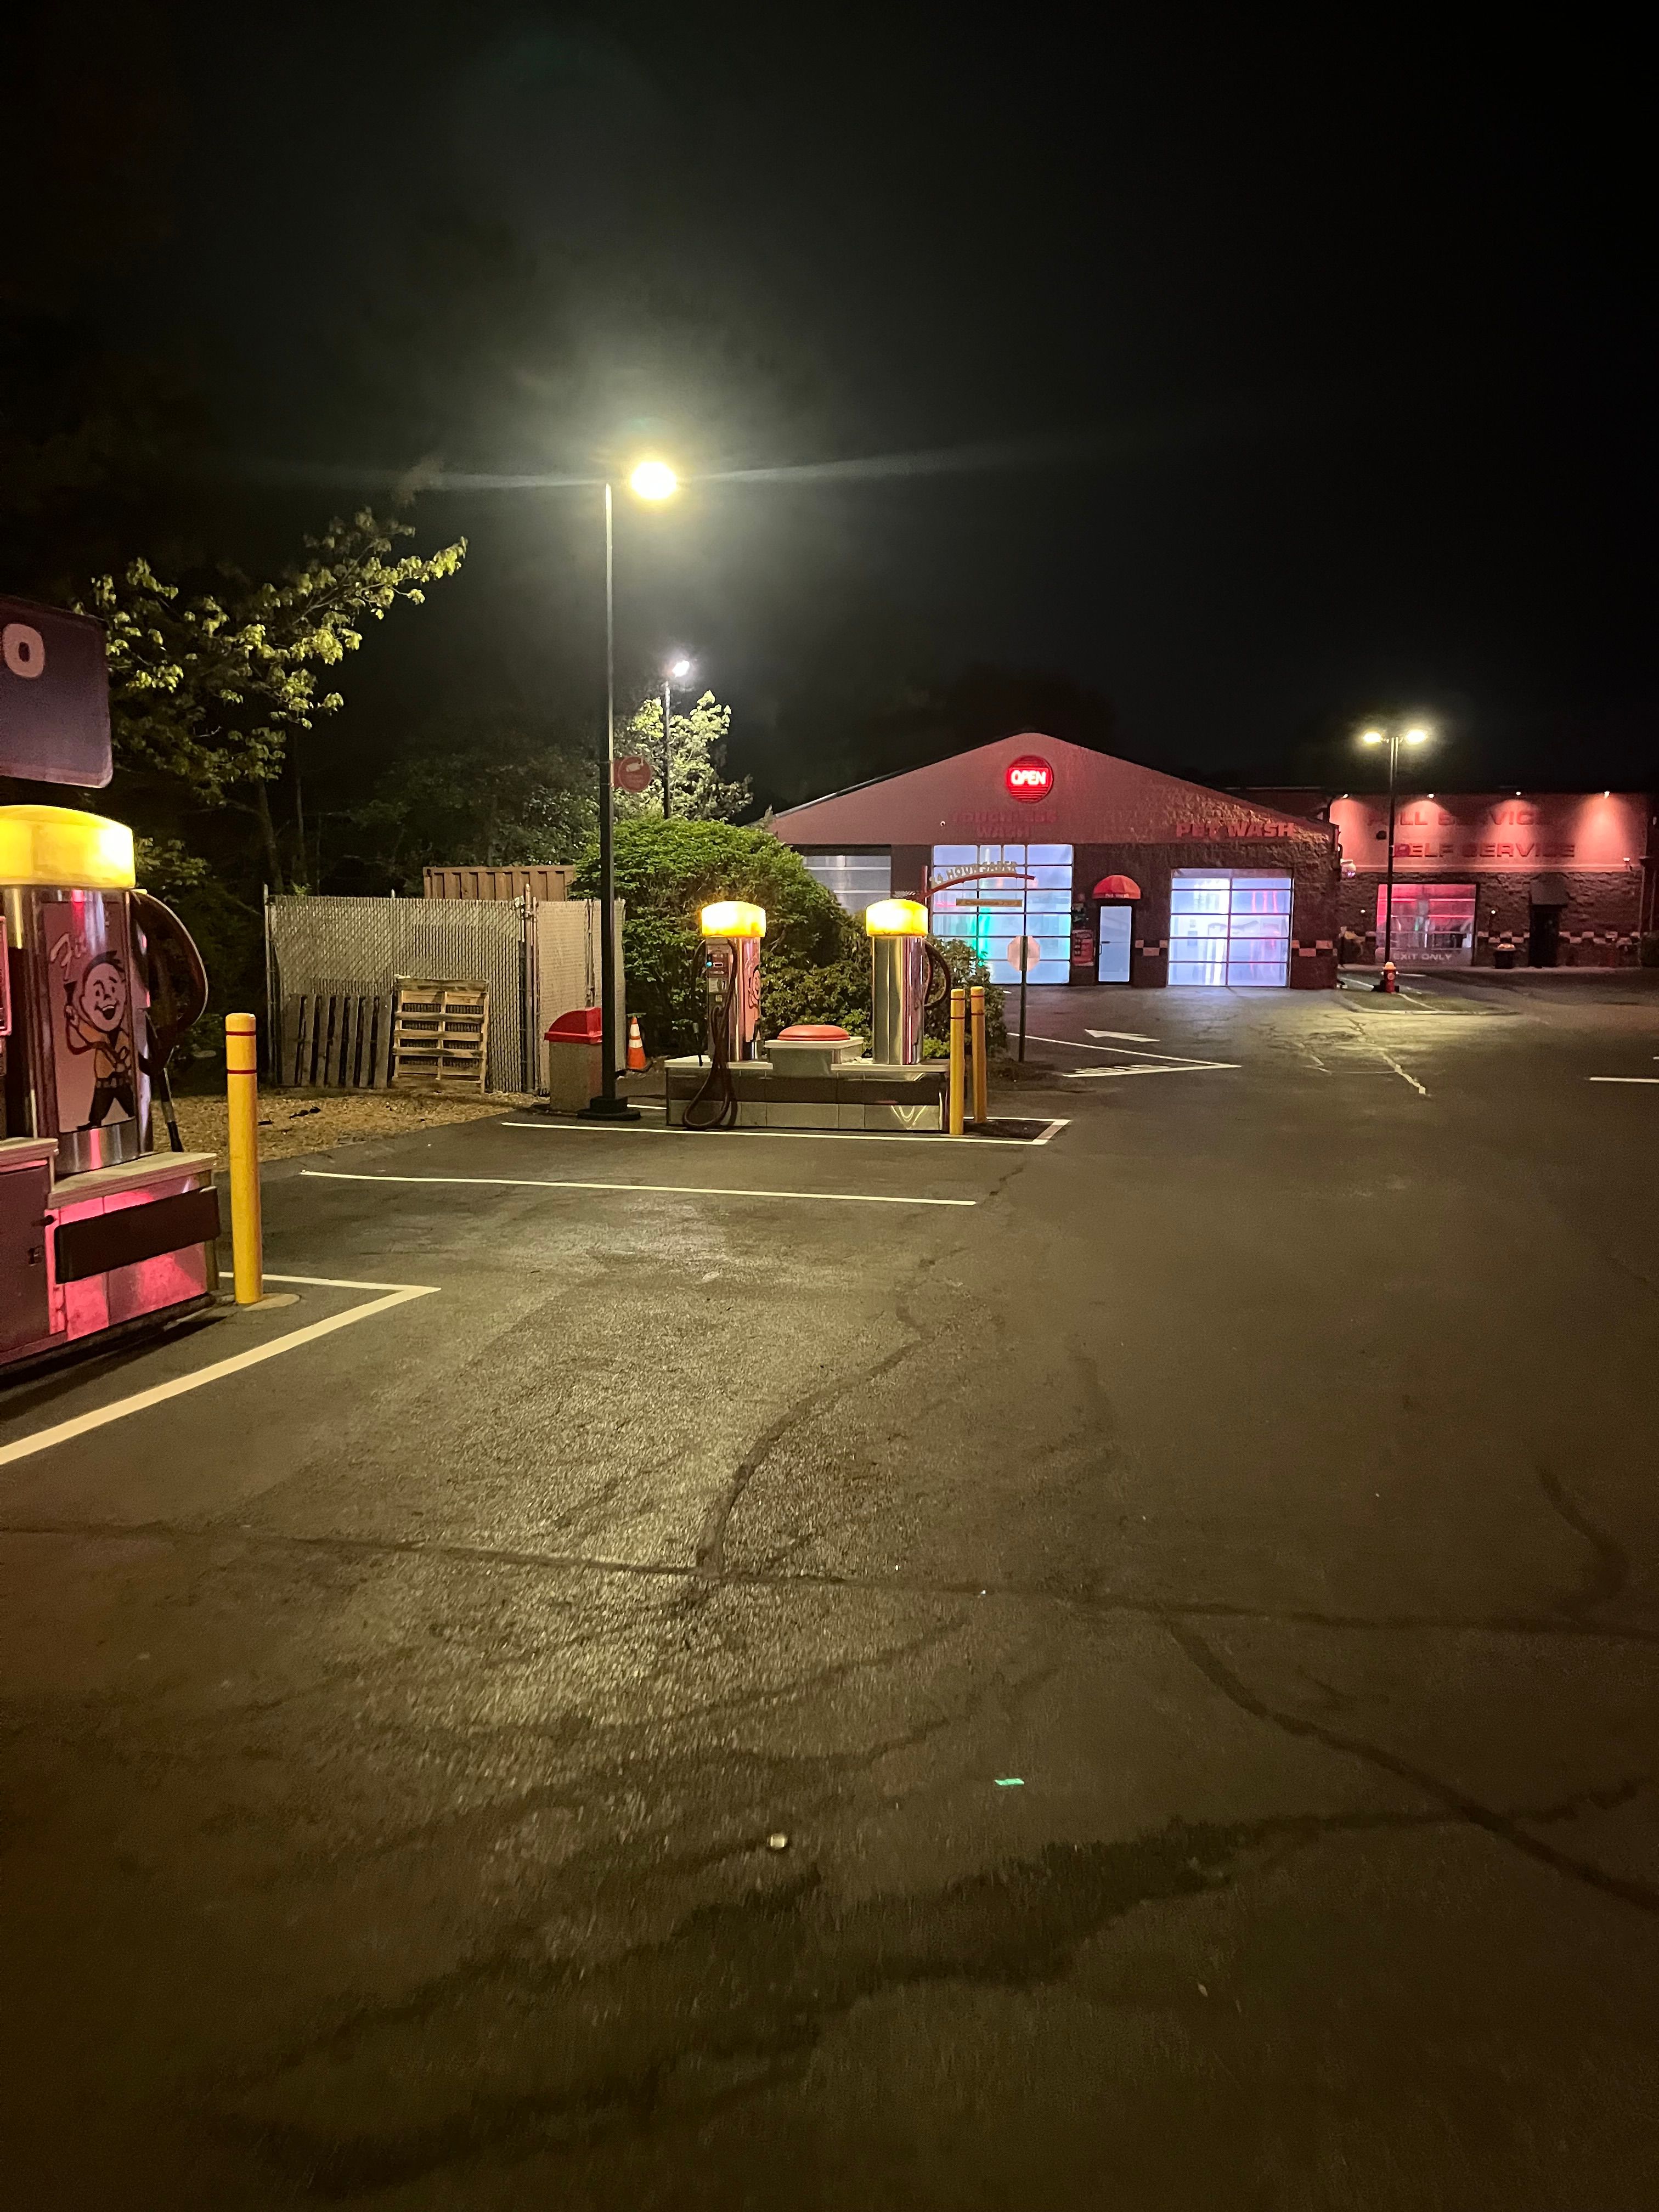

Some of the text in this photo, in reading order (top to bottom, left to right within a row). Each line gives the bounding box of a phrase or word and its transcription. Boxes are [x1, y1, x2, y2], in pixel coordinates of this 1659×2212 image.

[1011, 770, 1046, 785] OPEN
[1438, 811, 1552, 826] SVIC
[1176, 822, 1295, 838] PET WASH
[1394, 843, 1576, 858] ELF SERVICE
